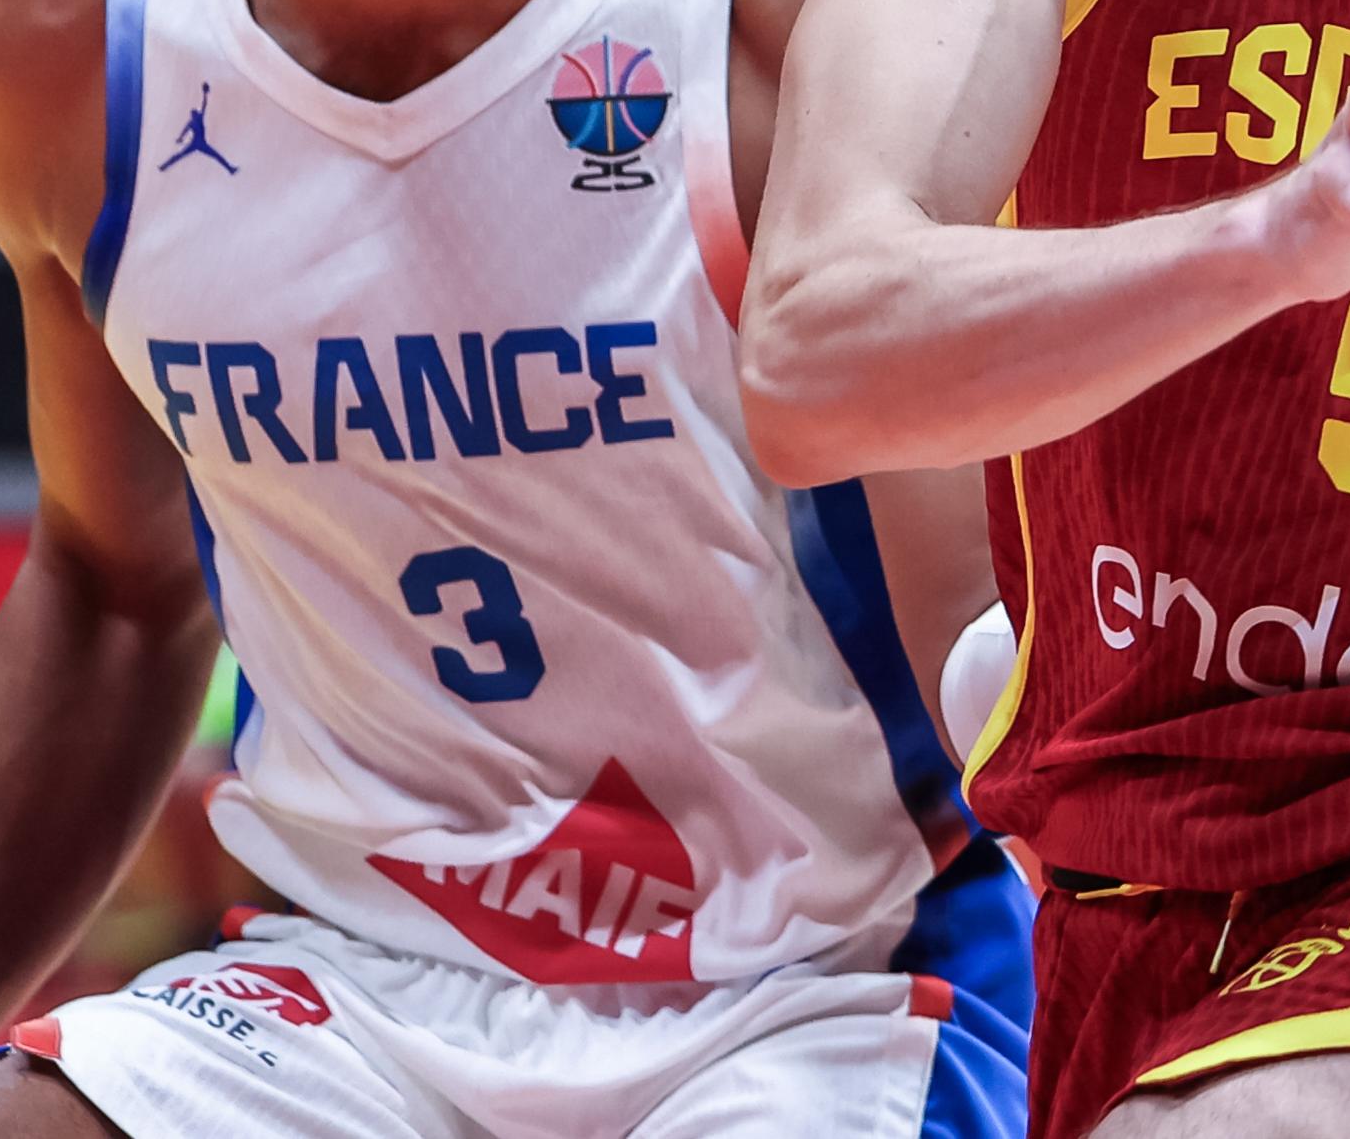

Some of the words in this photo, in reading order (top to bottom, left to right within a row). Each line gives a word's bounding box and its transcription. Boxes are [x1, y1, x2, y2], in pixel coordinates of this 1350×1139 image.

[570, 153, 656, 192] 25
[147, 320, 676, 464] FRANCE
[398, 545, 547, 703] 3
